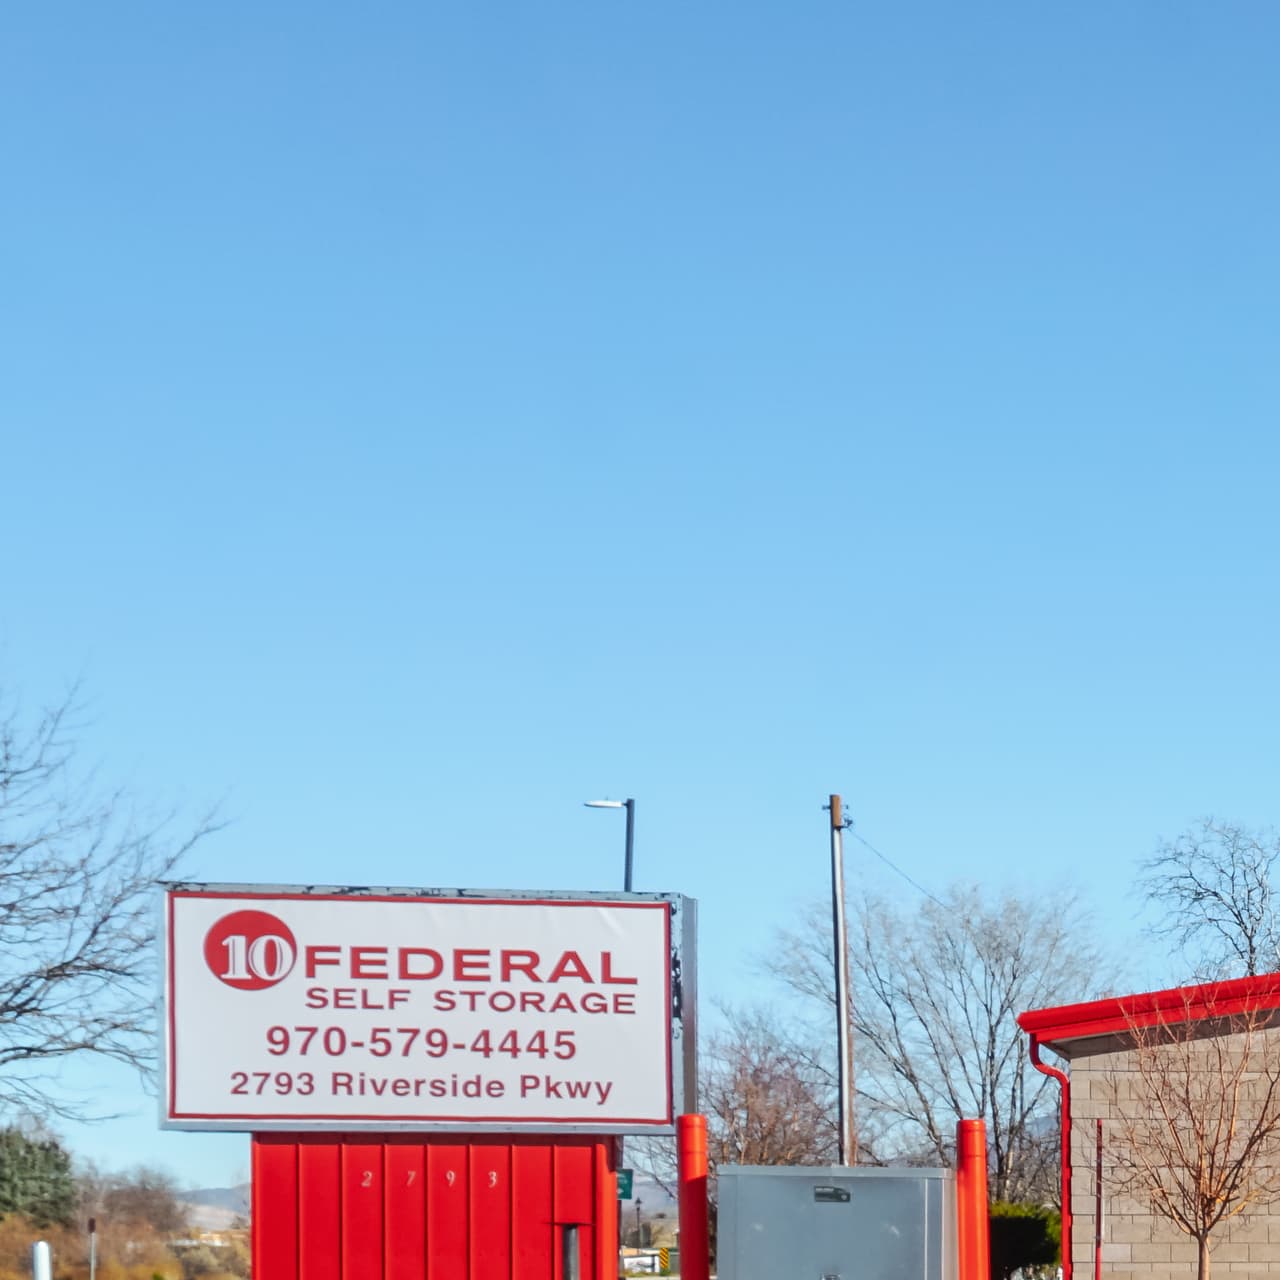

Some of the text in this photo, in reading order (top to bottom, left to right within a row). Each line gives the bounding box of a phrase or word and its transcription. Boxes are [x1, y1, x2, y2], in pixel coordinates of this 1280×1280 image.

[221, 935, 638, 985] 10 FEDERAL
[305, 987, 637, 1015] SELF STORAGE
[266, 1026, 577, 1060] 970-579-4445
[230, 1072, 613, 1105] 2793 Riverside Pkwy
